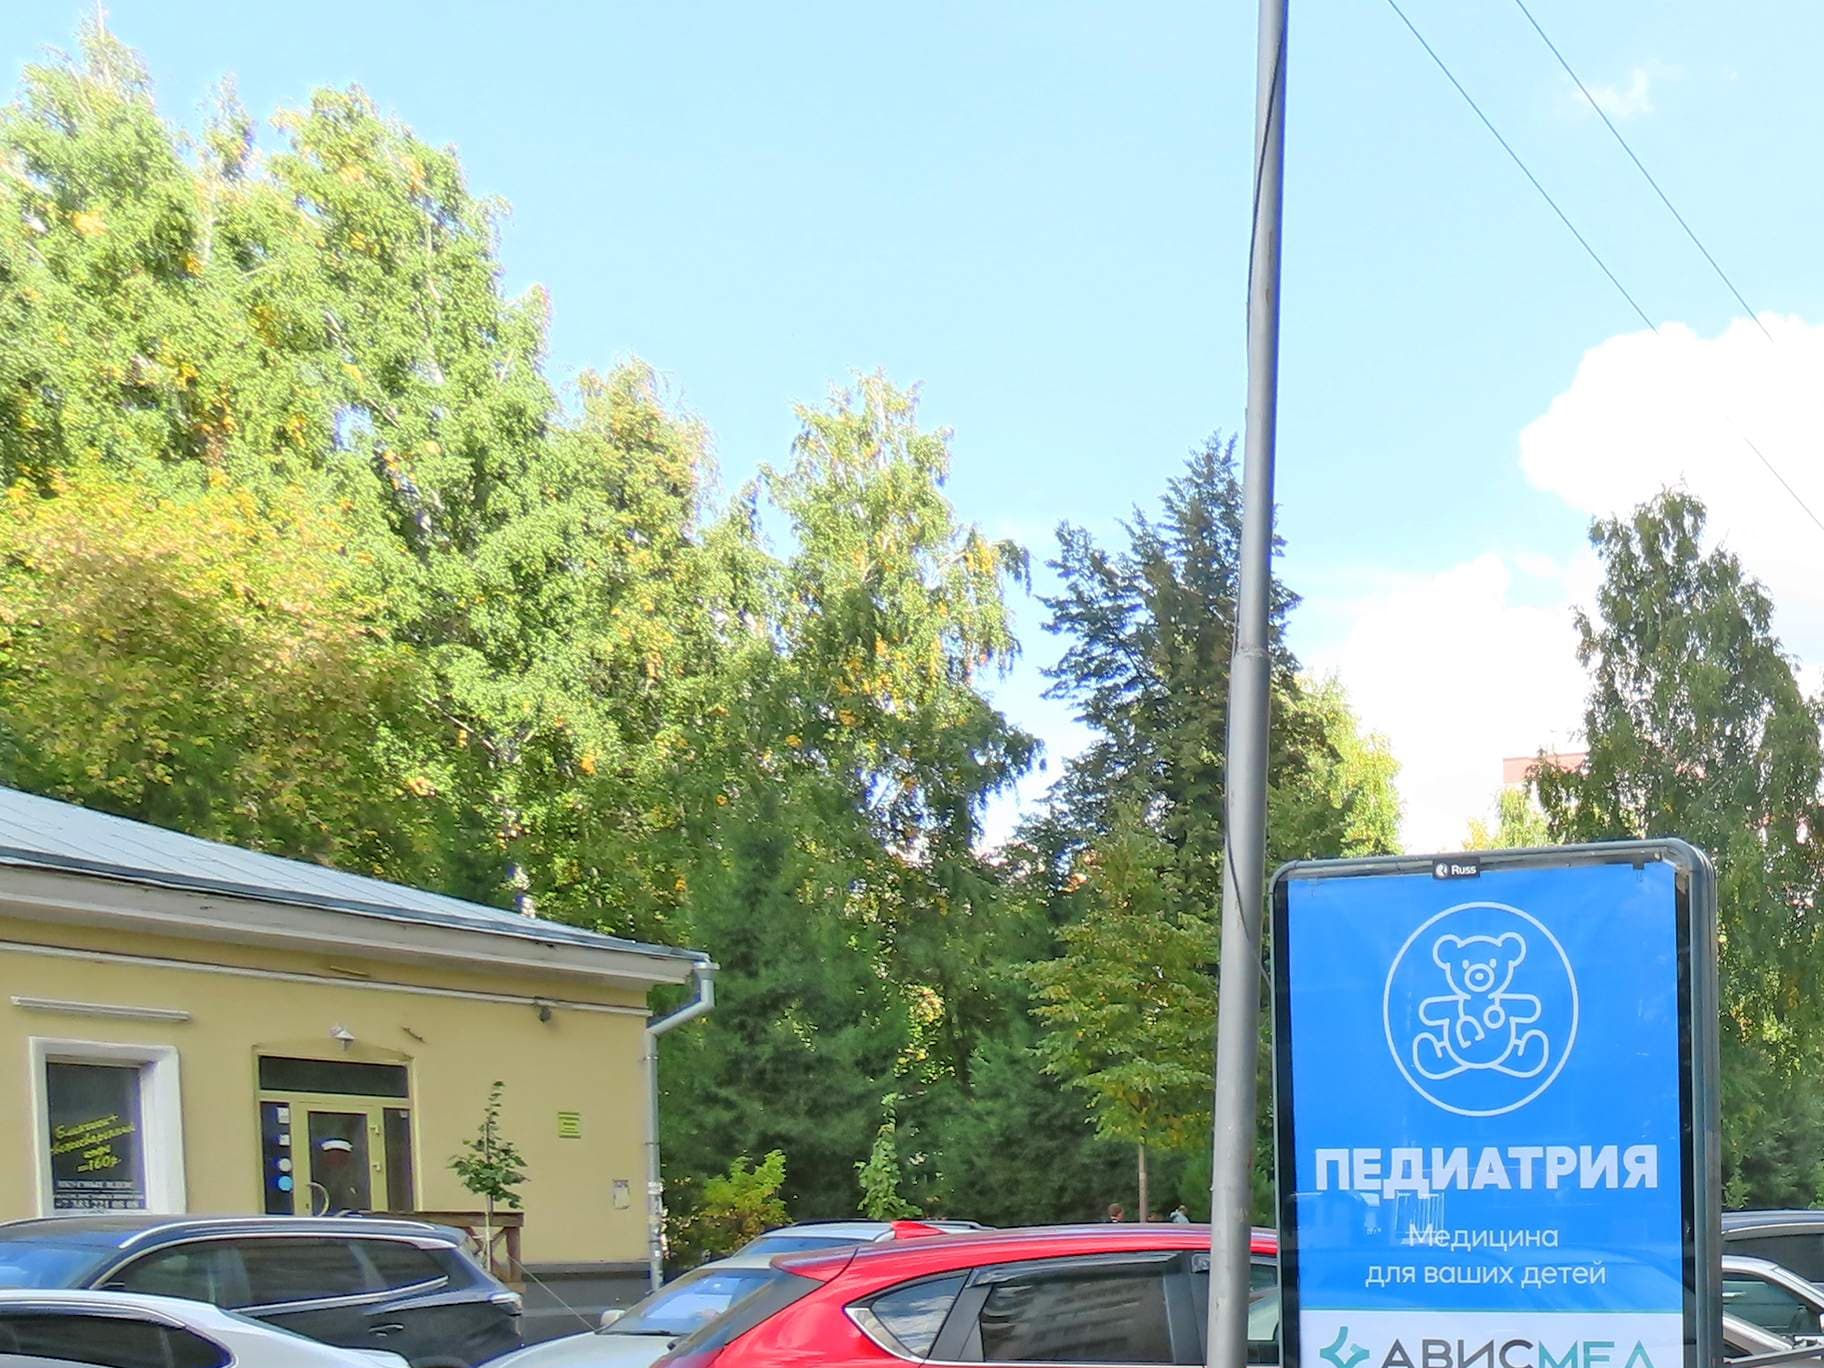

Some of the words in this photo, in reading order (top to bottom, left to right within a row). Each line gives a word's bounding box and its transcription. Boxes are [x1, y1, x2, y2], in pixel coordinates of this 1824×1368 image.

[1451, 864, 1477, 875] Russ
[1315, 1145, 1658, 1199] ПЕДИАТРИЯ
[1408, 1224, 1559, 1252] Медицина
[1364, 1264, 1416, 1287] для
[1424, 1264, 1514, 1284] ваших
[1521, 1260, 1608, 1288] детей
